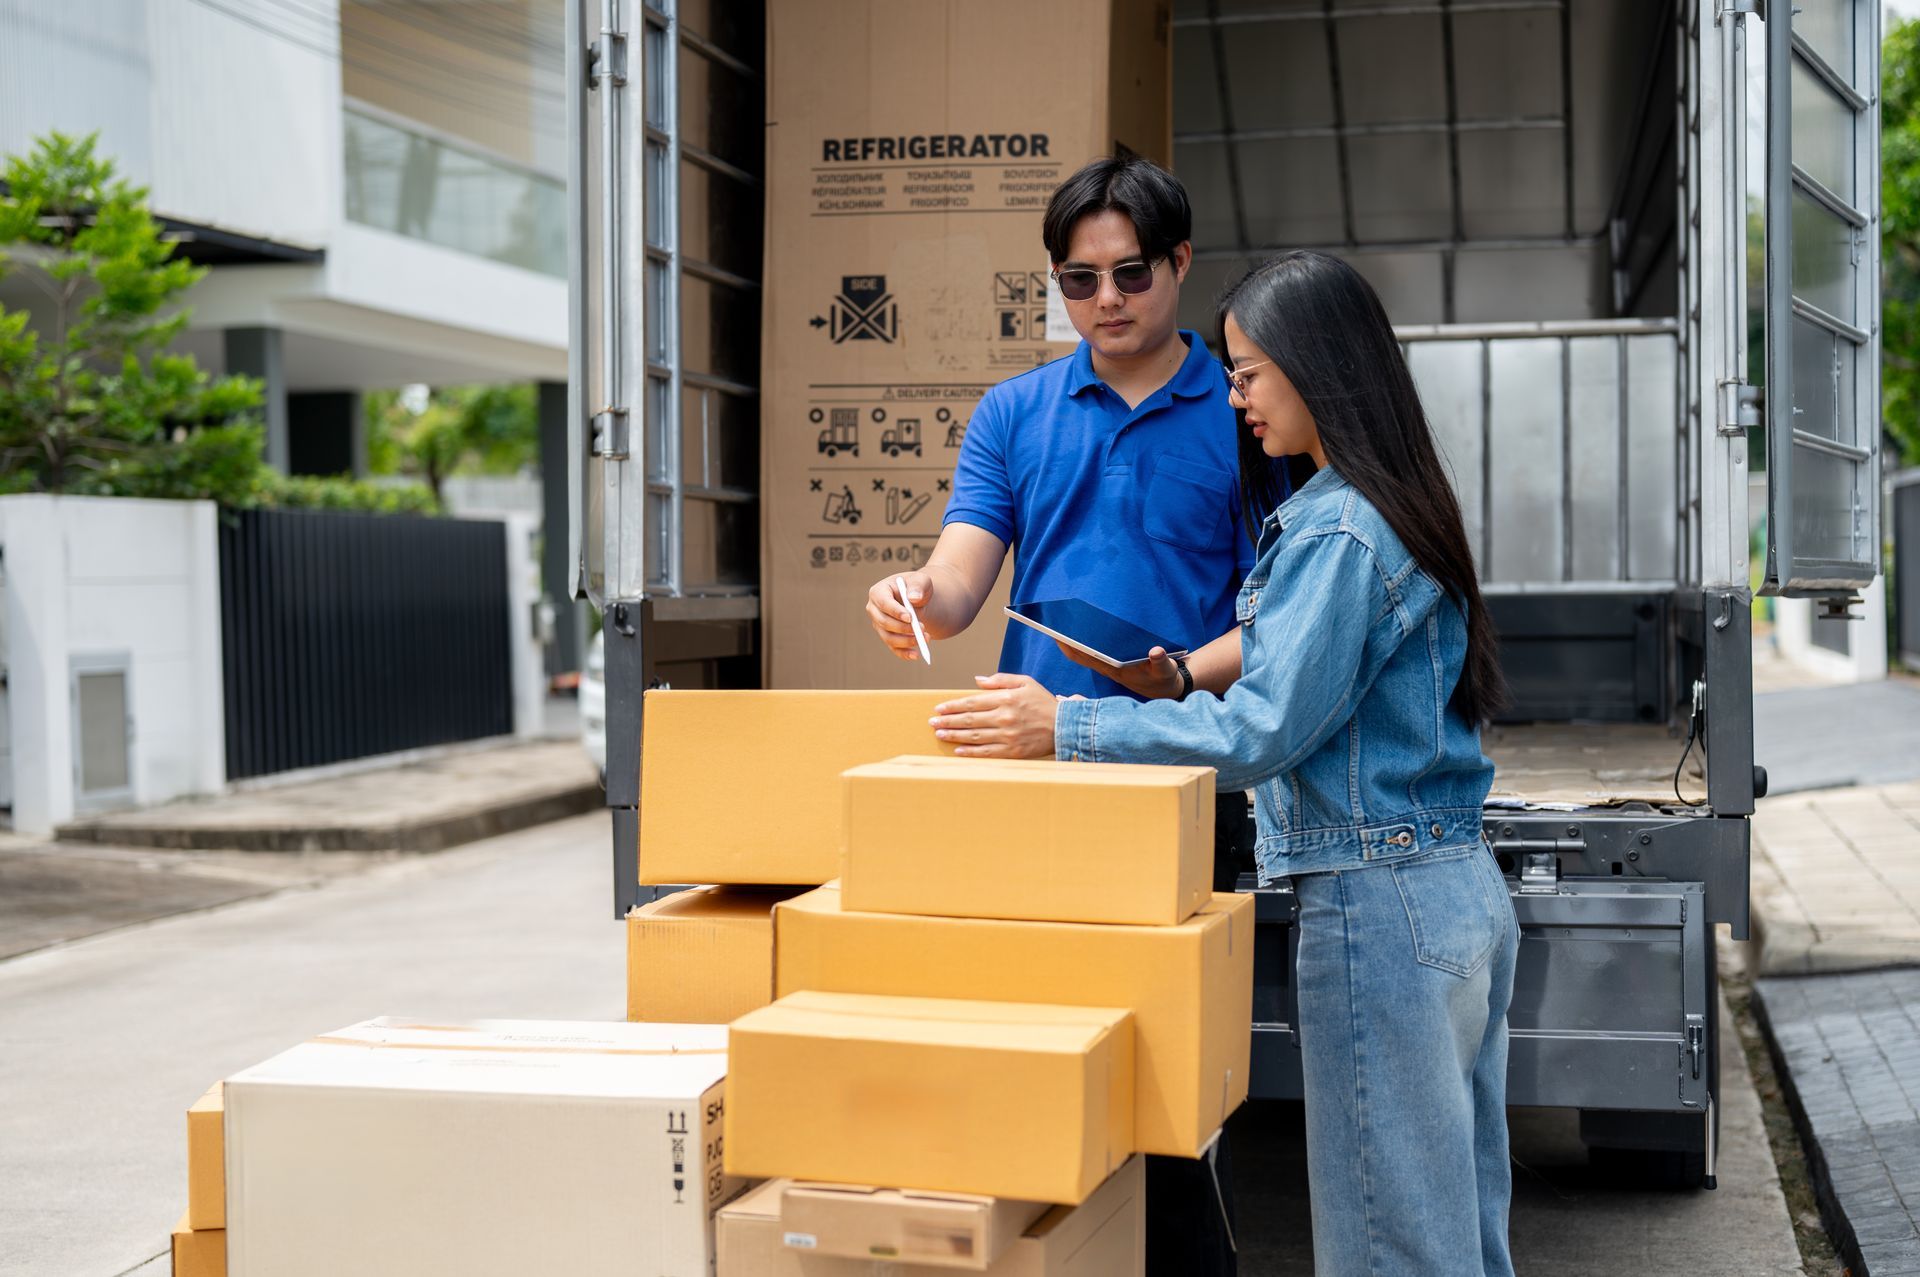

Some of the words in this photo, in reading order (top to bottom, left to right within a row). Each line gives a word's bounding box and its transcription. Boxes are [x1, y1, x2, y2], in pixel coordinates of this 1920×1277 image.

[823, 134, 1049, 161] REFRIGERATOR
[851, 279, 877, 291] SIDE
[897, 388, 940, 398] DELIVERY
[943, 387, 985, 397] CAUTION
